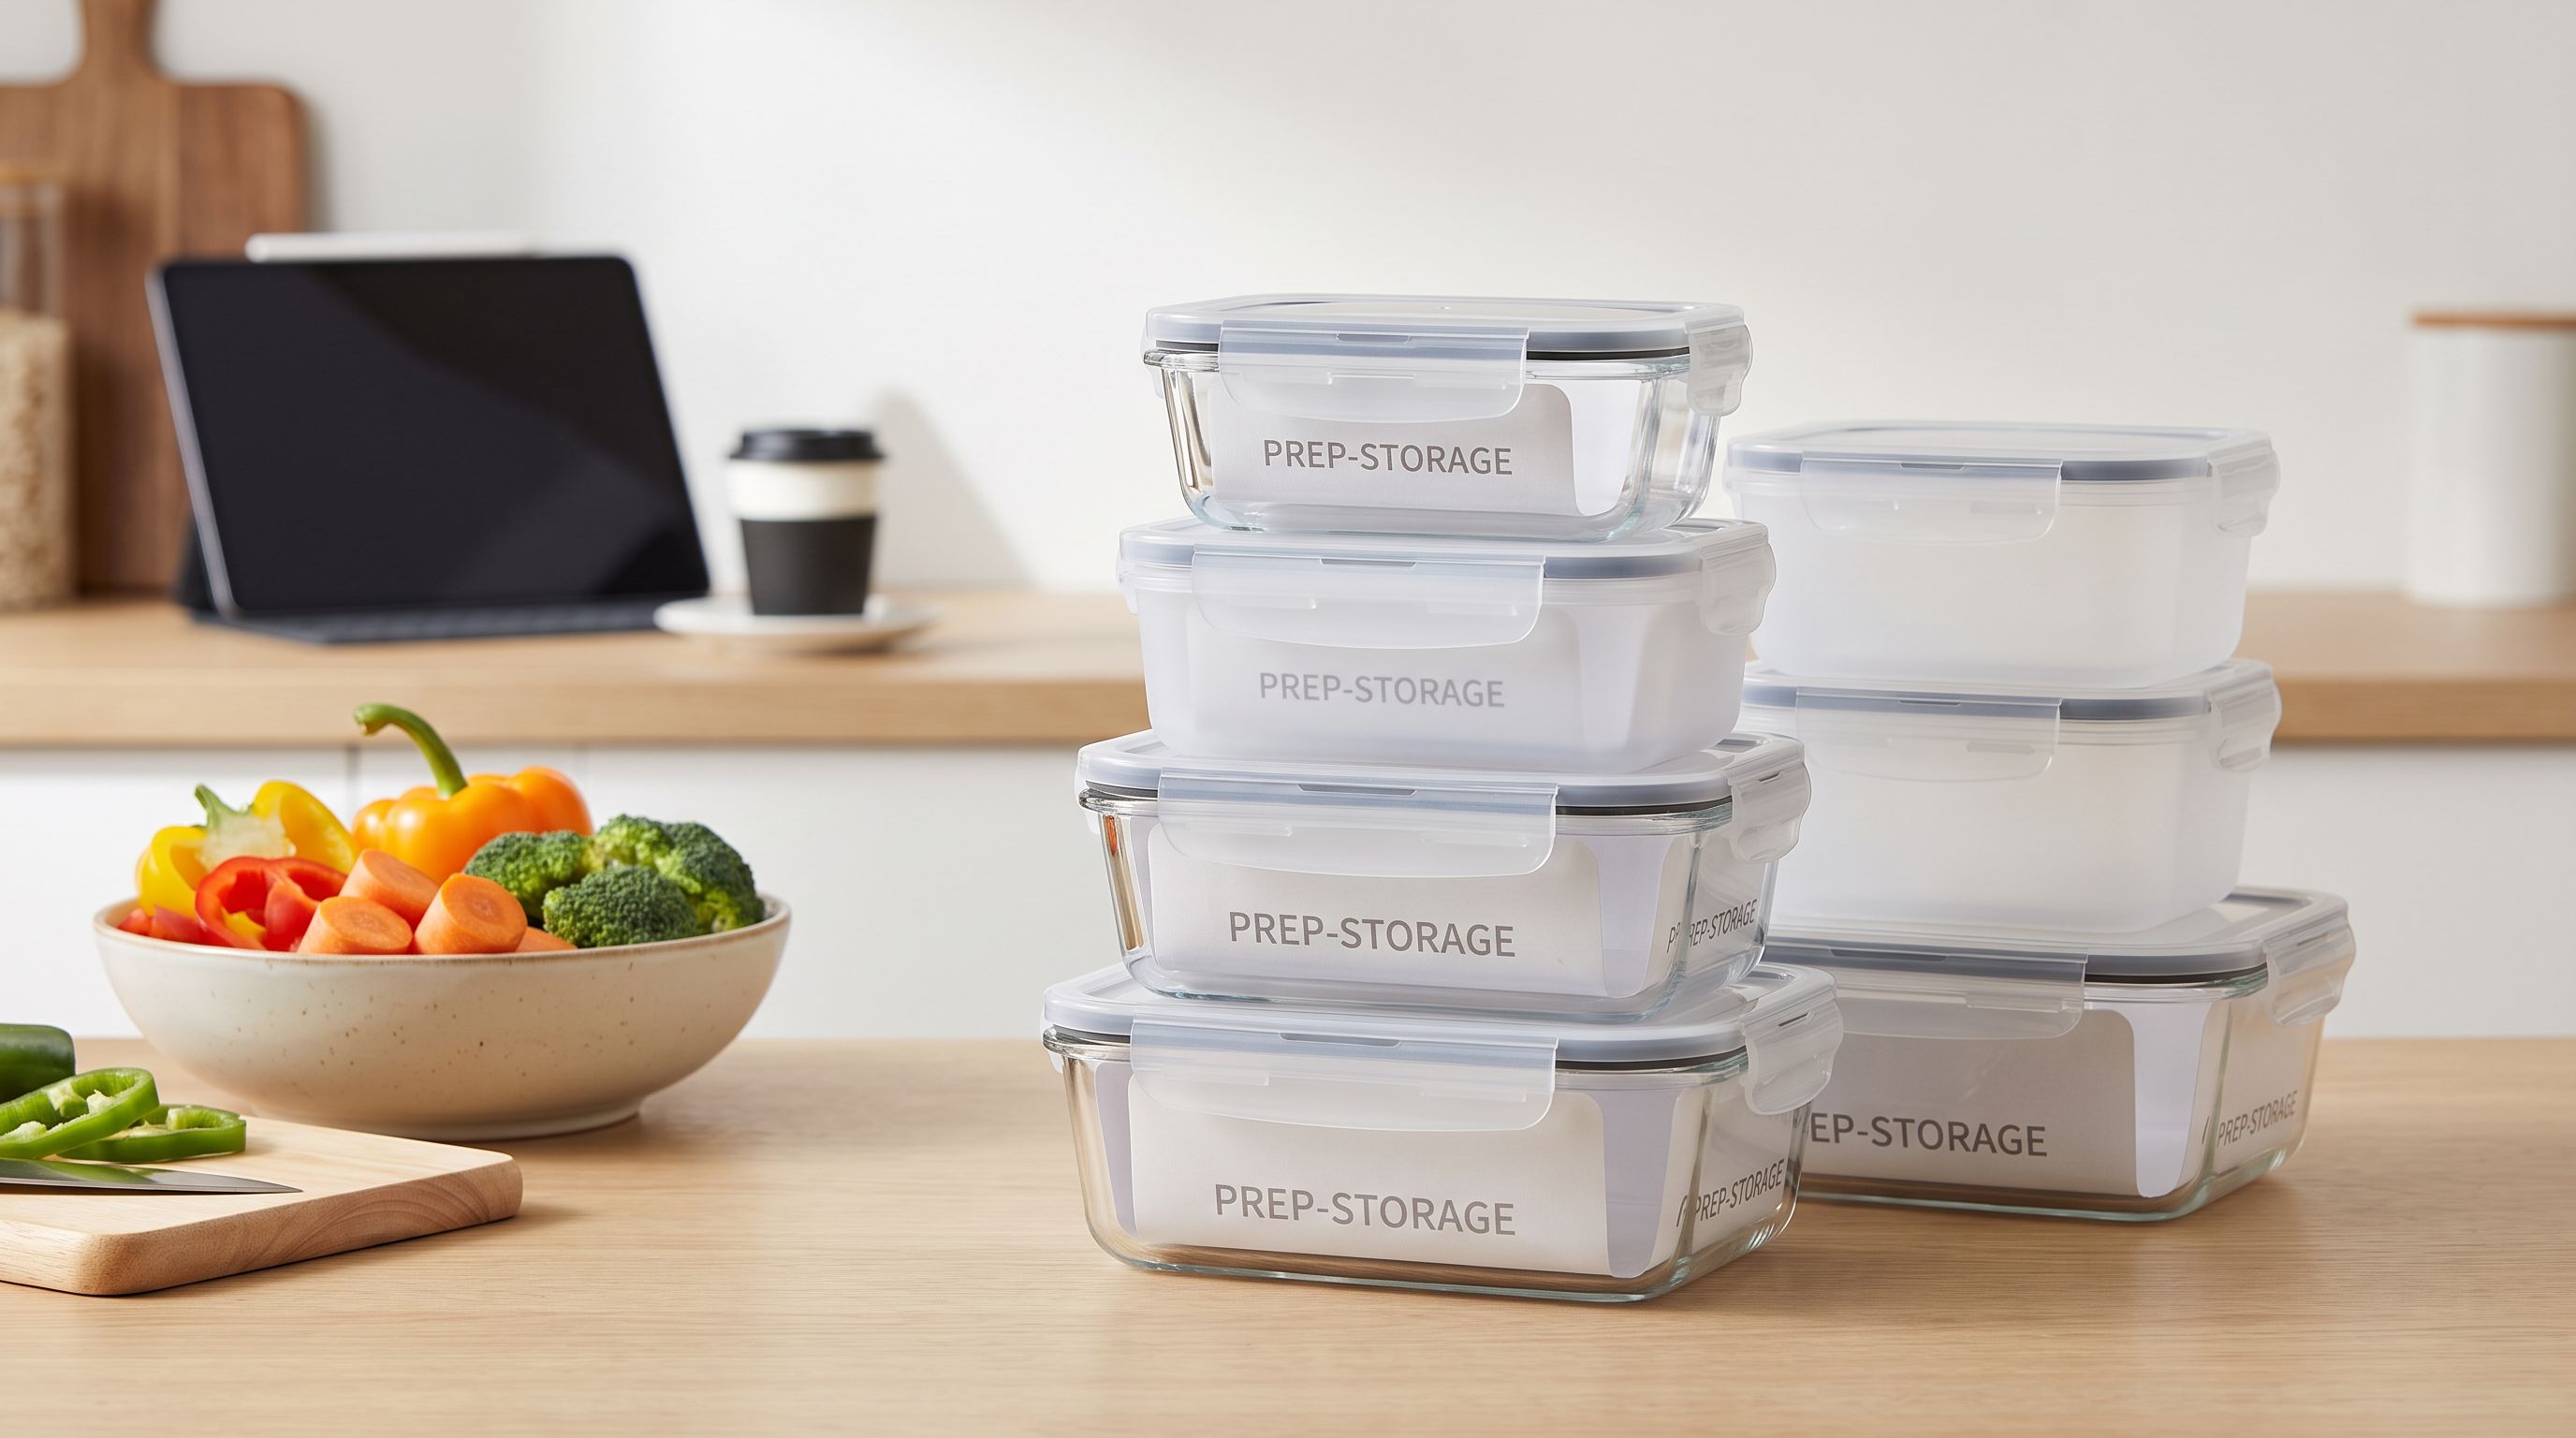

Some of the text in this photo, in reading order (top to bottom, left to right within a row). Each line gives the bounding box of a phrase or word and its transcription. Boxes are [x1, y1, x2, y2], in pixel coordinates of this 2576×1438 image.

[1264, 439, 1513, 476] PREP-STORAGE
[1259, 672, 1505, 708] PREP-STORAGE
[1229, 911, 1515, 958] PREP-STORAGE
[1810, 1111, 2048, 1157] EP-STORAGE
[2216, 1090, 2298, 1148] PREP-STORAGE
[1215, 1183, 1515, 1236] PREP-STORAGE
